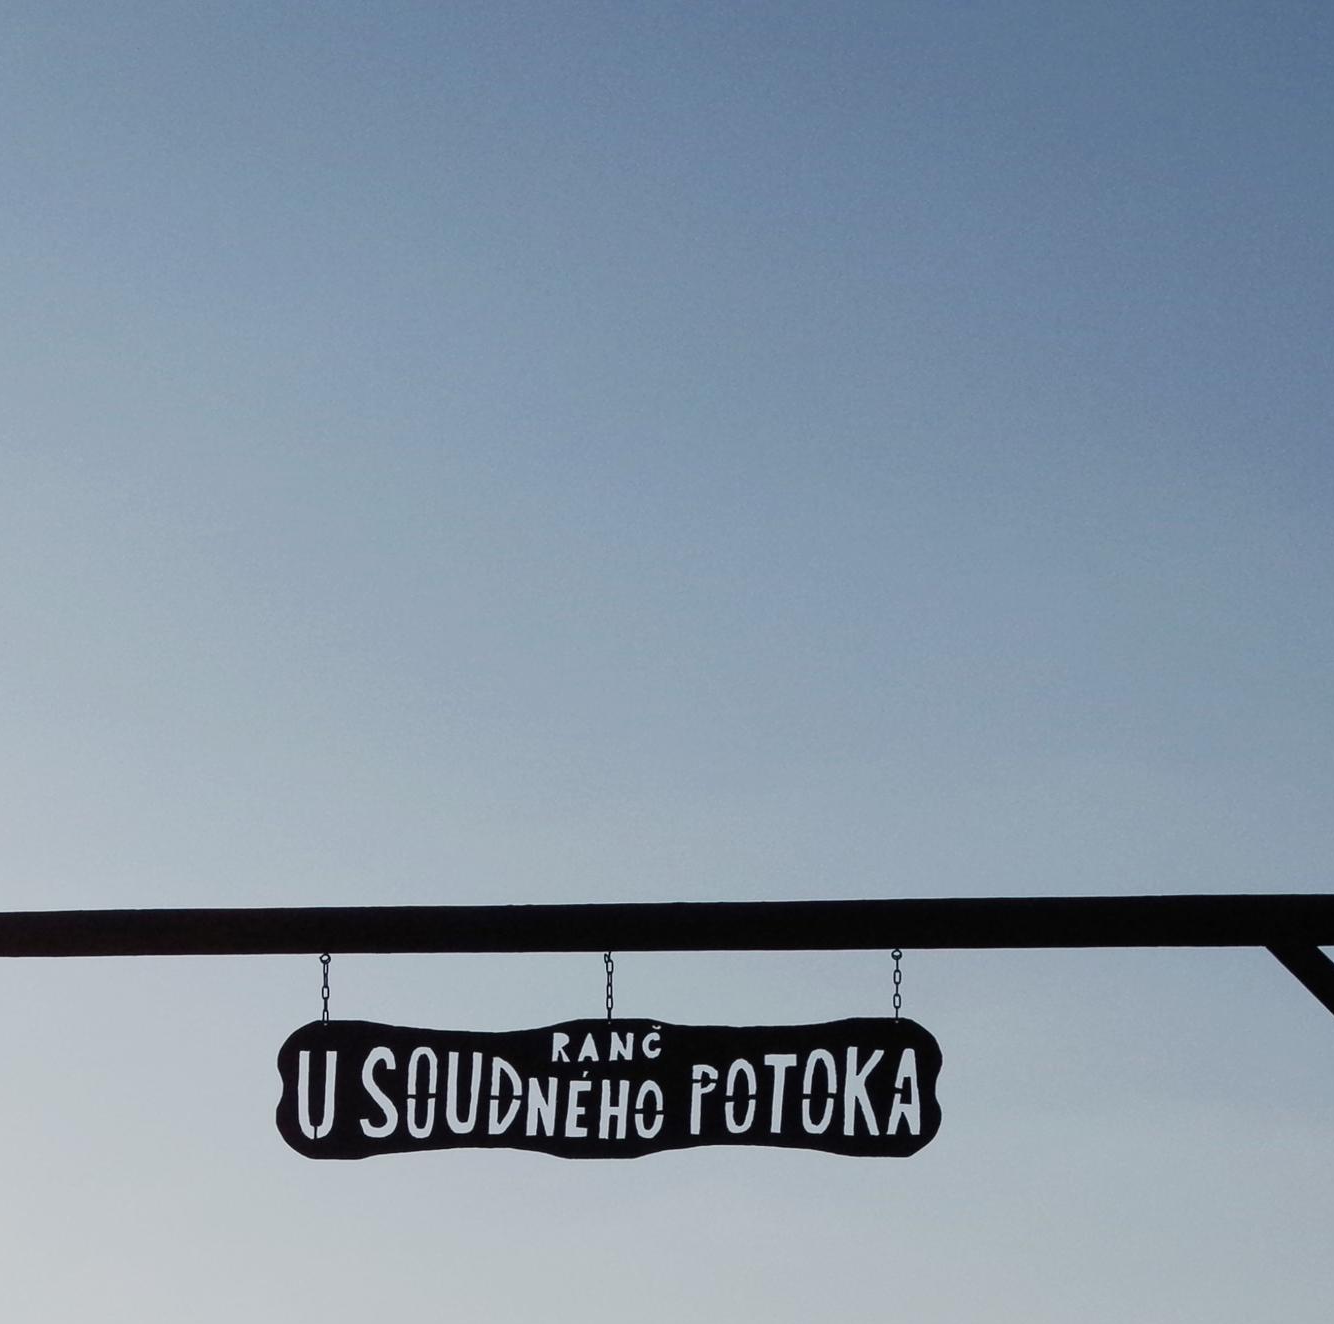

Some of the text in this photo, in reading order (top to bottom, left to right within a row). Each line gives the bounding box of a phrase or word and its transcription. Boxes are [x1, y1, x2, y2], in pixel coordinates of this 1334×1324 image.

[551, 1024, 663, 1063] RANČ
[297, 1046, 922, 1140] U SOUDNÉHO POTOKA
